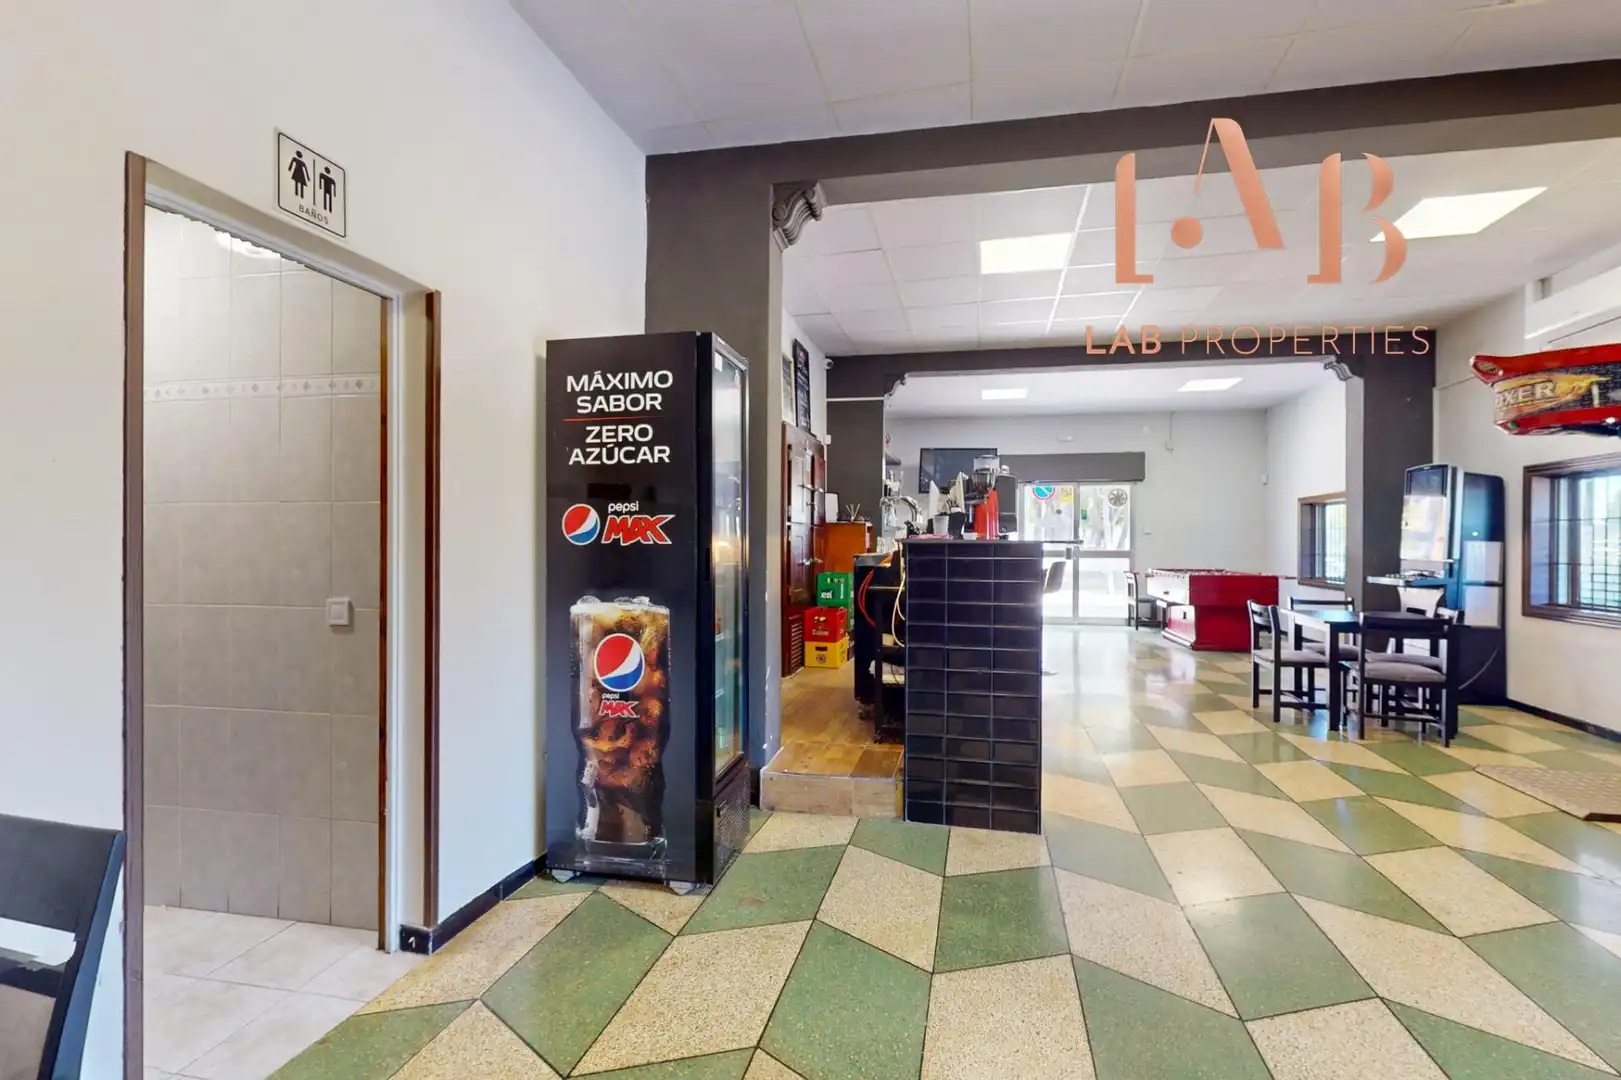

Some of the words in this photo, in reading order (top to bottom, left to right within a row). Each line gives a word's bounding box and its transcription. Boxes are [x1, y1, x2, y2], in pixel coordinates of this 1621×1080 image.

[298, 204, 329, 225] BAÑOS
[566, 370, 673, 393] MÁXIMO
[576, 393, 662, 414] SABOR
[1495, 380, 1556, 408] OXER
[585, 424, 653, 444] ZERO
[568, 444, 671, 466] AZÚCAR
[608, 501, 639, 514] pepsi
[601, 514, 676, 547] MAX
[598, 700, 640, 719] MAX
